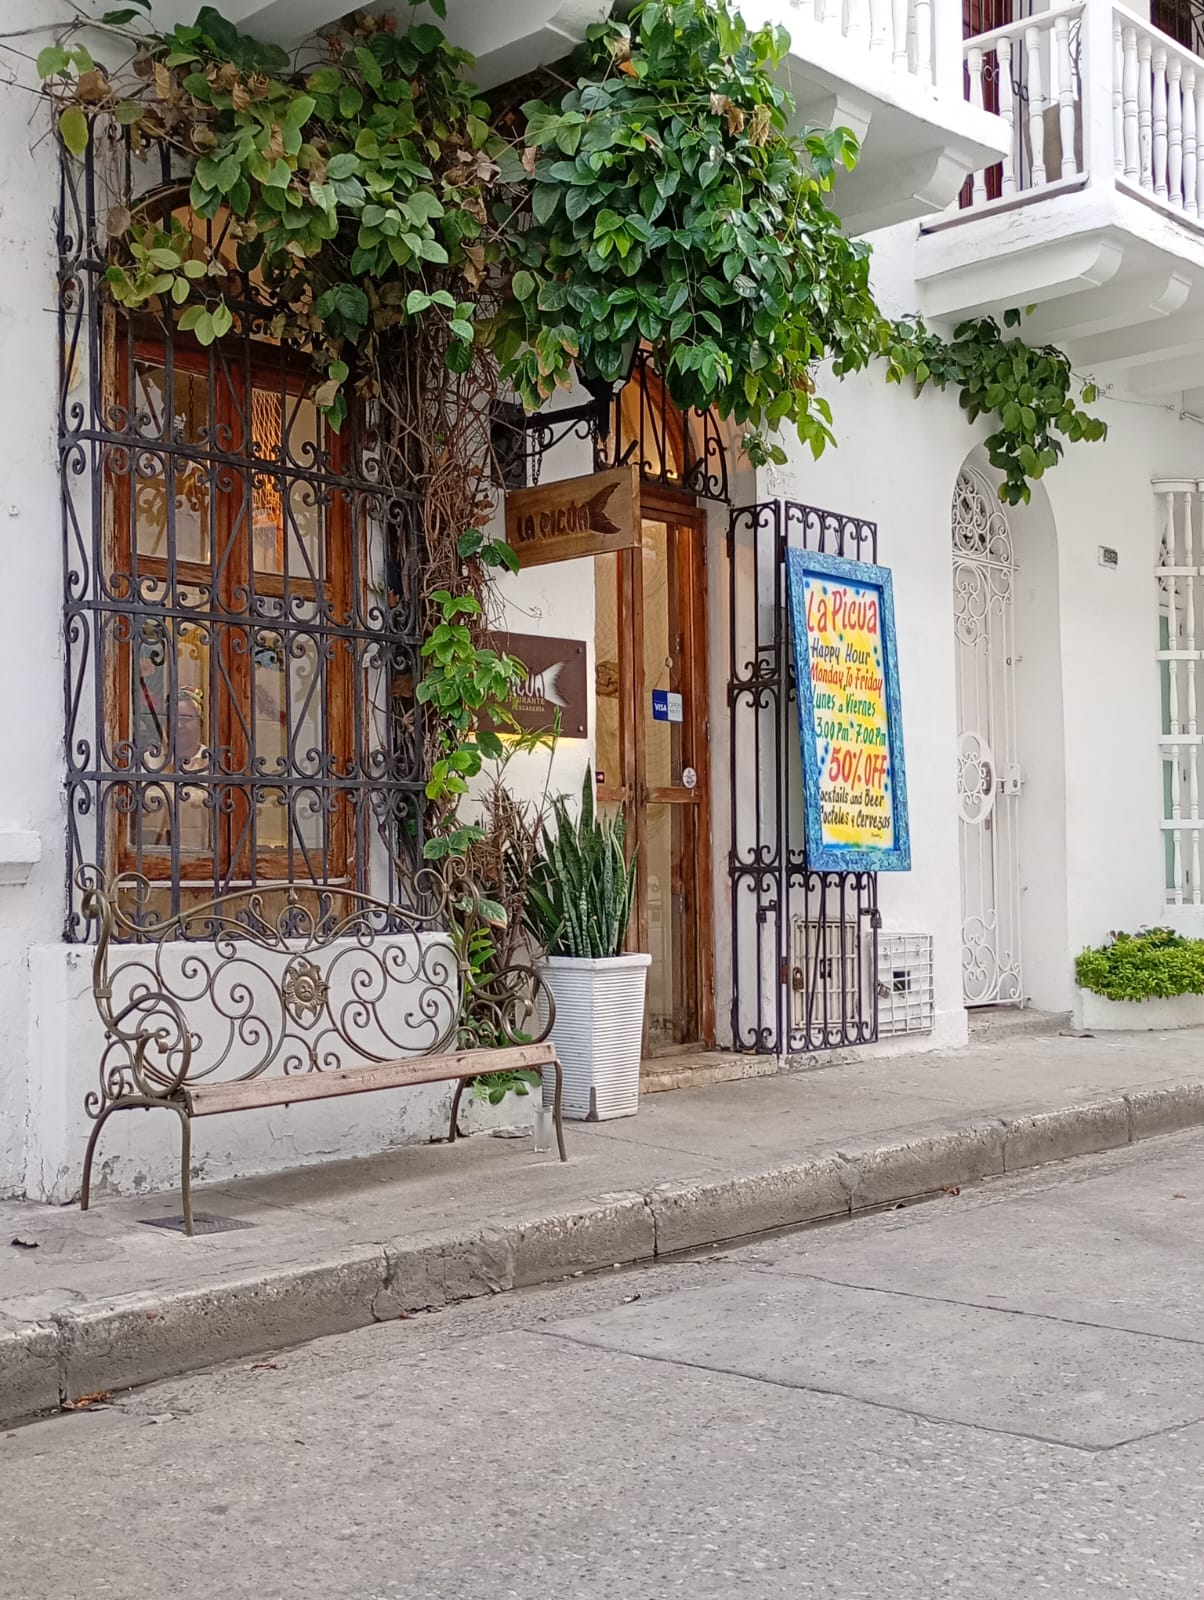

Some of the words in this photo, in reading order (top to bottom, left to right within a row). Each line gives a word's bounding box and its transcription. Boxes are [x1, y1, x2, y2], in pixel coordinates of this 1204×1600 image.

[517, 514, 535, 542] LA
[807, 591, 827, 632] La
[811, 637, 840, 665] Happy
[845, 643, 870, 665] Hour
[811, 662, 844, 689] Monday
[855, 667, 883, 698] Friday
[654, 702, 667, 711] VISA
[846, 692, 876, 717] Viernes
[829, 747, 862, 790] 50%
[864, 753, 887, 789] OFF
[850, 792, 862, 805] and
[865, 789, 884, 807] Beer
[856, 809, 891, 830] Cervezas
